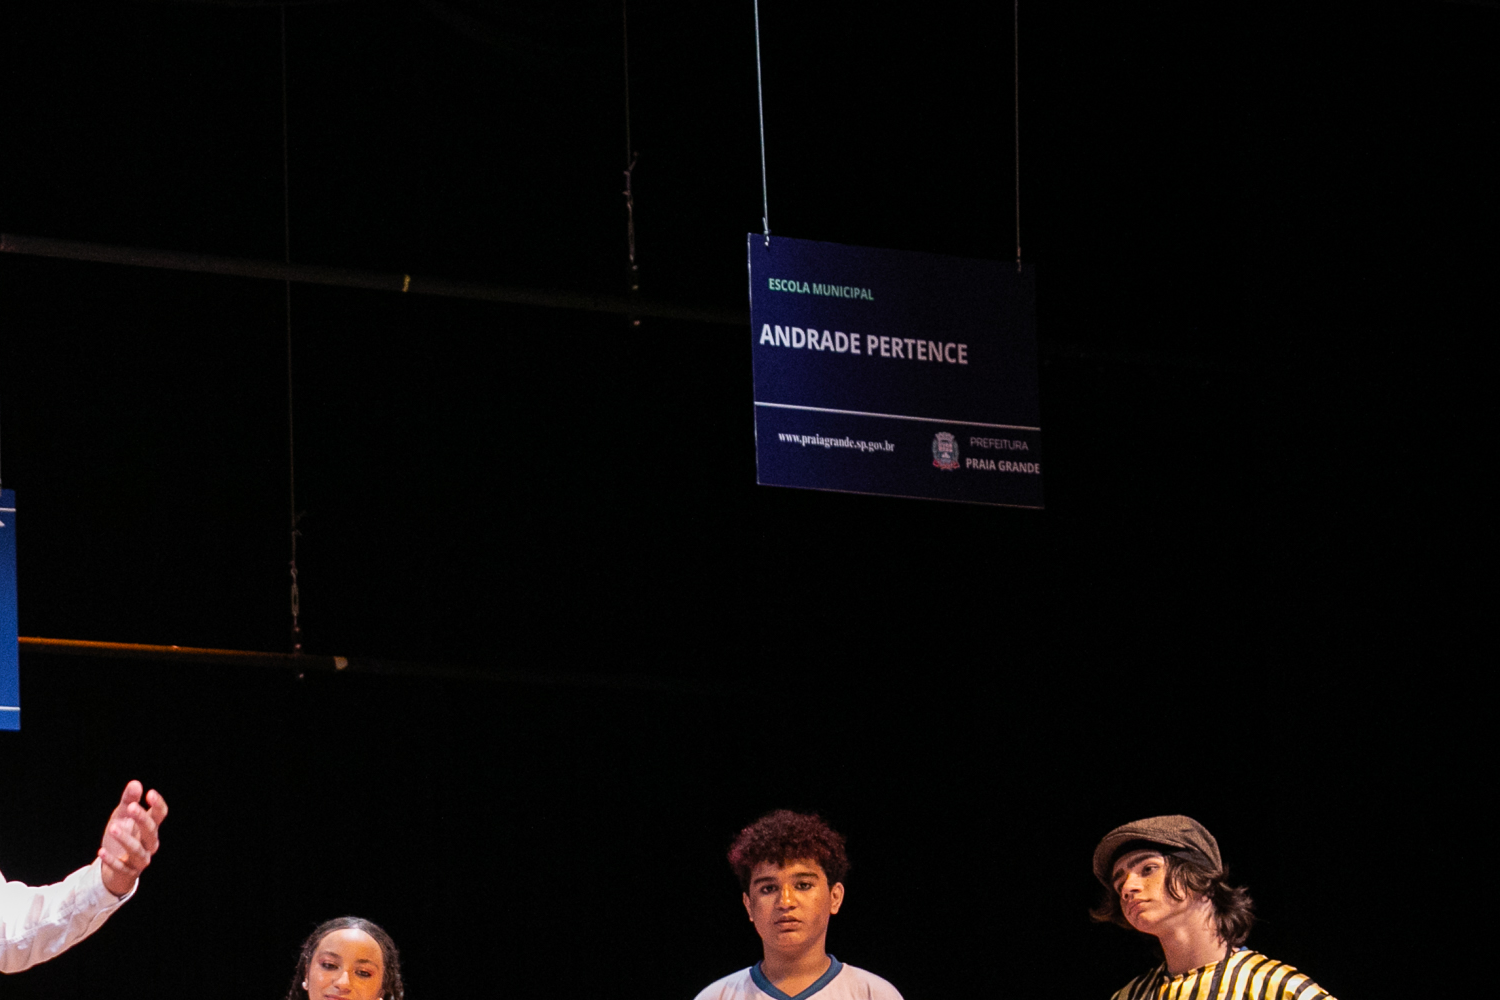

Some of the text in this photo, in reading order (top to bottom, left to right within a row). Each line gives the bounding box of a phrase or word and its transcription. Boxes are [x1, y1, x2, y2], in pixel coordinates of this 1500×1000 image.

[768, 277, 874, 301] ESCOLA MUNICIPAL
[759, 323, 968, 365] ANDRADE PERTENCE
[778, 432, 895, 453] www.praiagrande.sp.gov.br
[970, 436, 1029, 451] PREFEITURA
[966, 457, 1040, 474] PRAIA GRANDE
